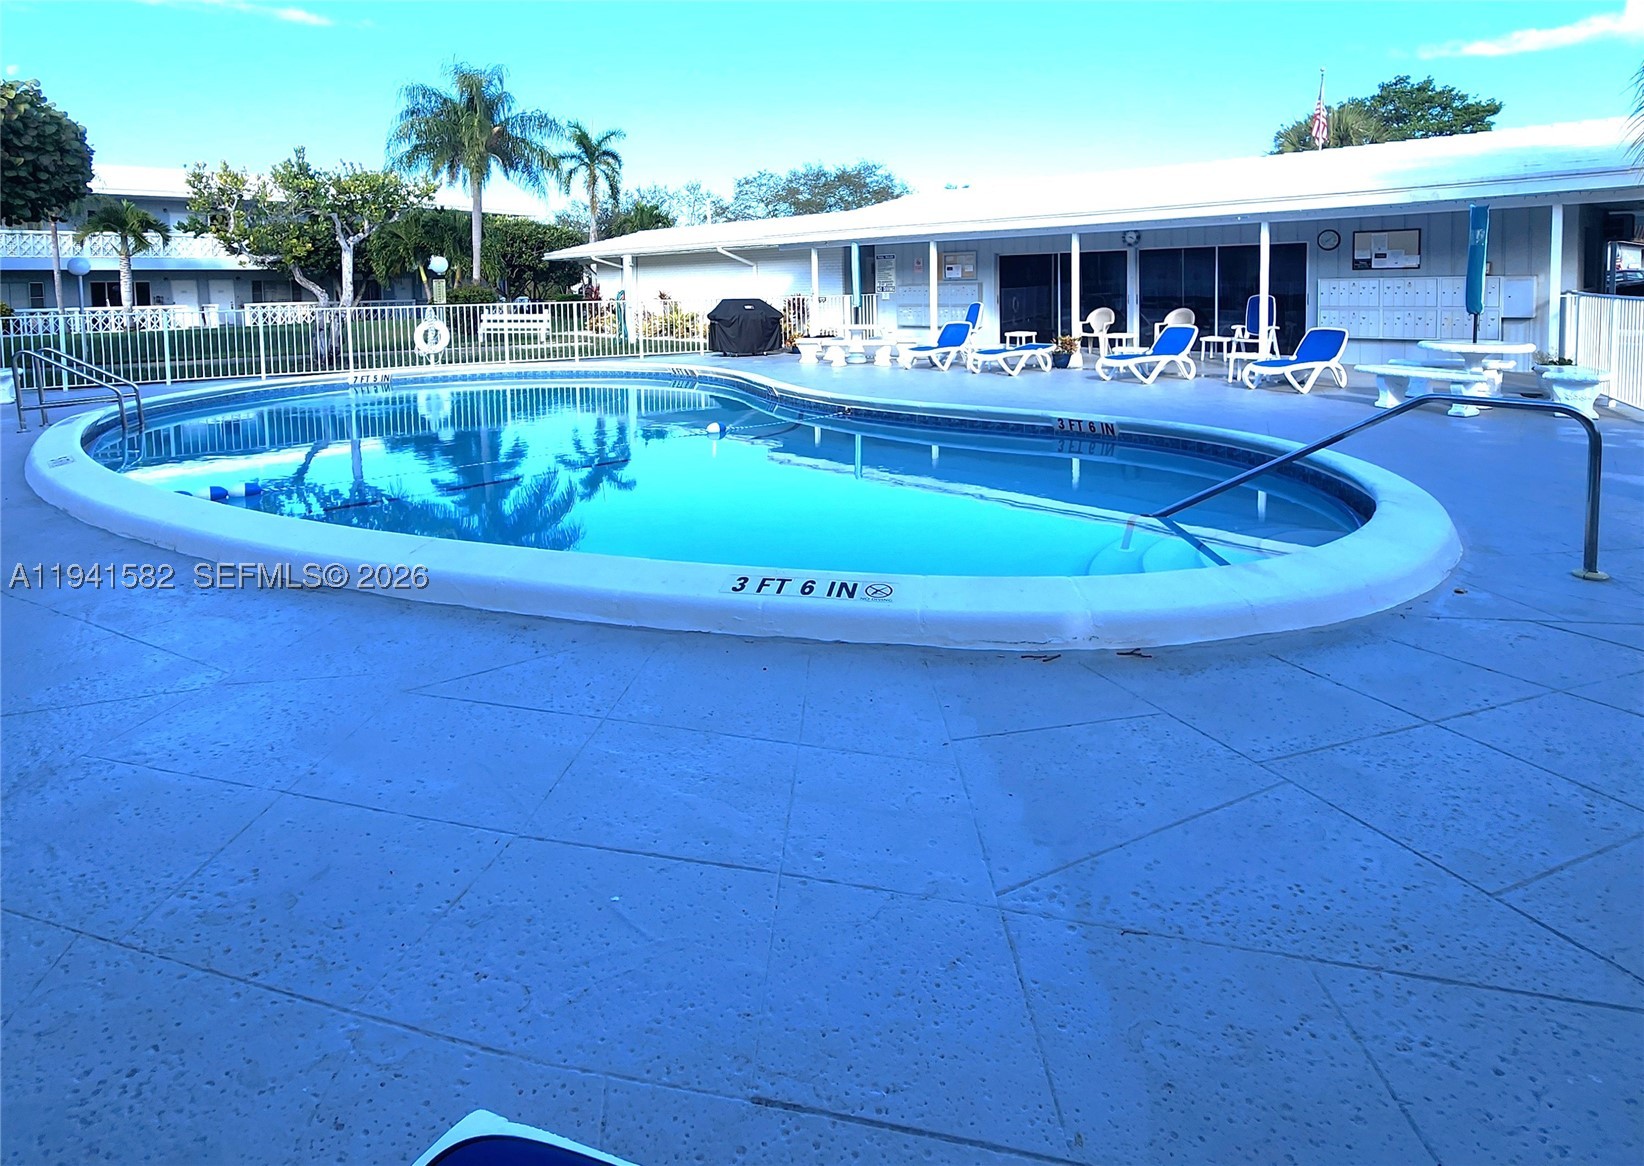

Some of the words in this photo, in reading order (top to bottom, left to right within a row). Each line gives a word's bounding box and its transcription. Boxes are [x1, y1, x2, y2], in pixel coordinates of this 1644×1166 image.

[353, 376, 358, 384] 7
[360, 375, 370, 383] FT
[381, 374, 390, 382] IN
[1057, 418, 1065, 430] 3
[1068, 419, 1083, 432] FT
[1088, 421, 1096, 433] 6
[1101, 422, 1115, 436] IN
[731, 576, 749, 592] 3
[755, 577, 792, 595] FT
[800, 580, 816, 595] 6
[826, 581, 858, 599] IN
